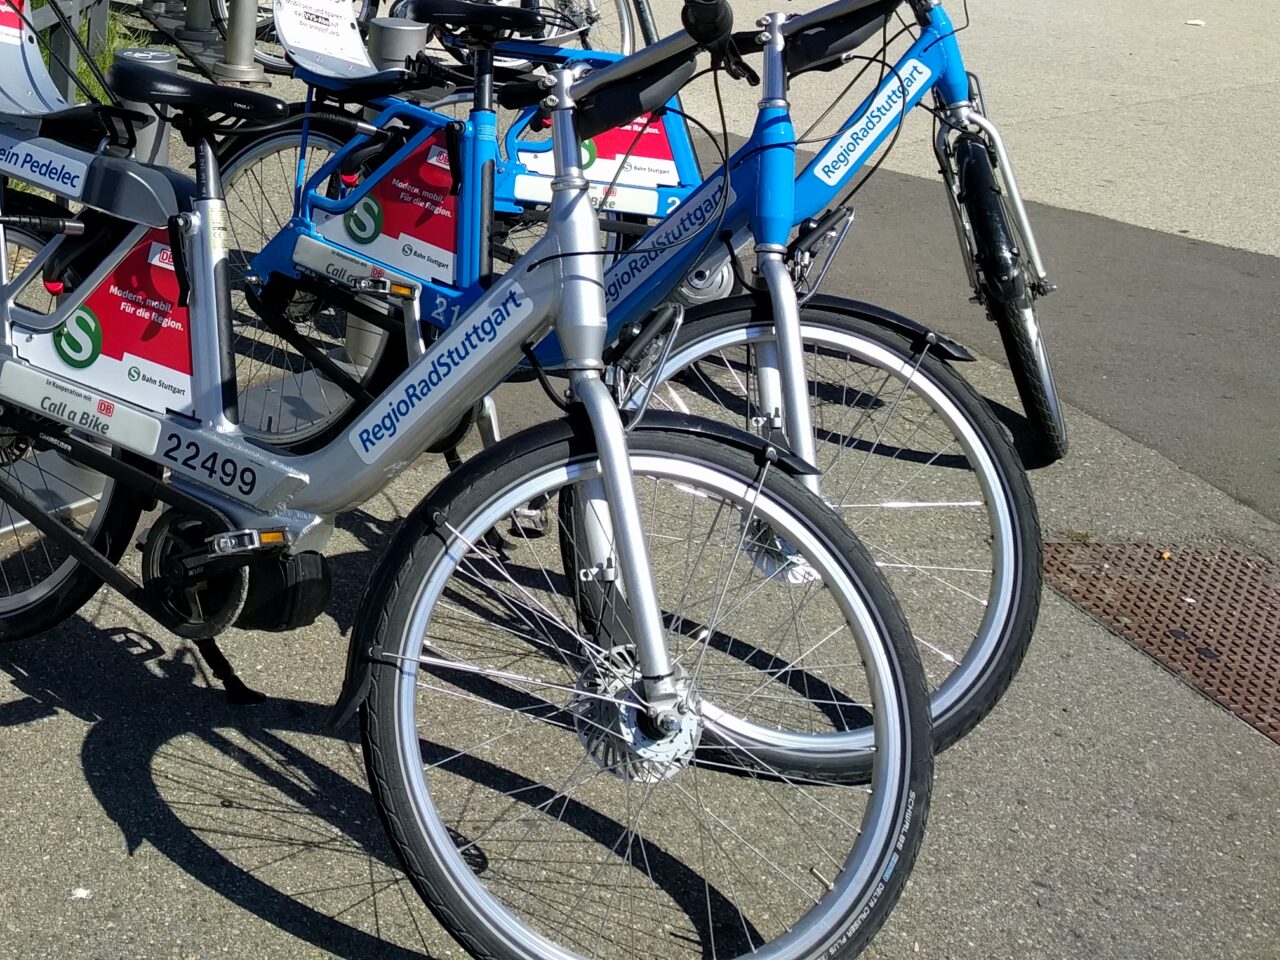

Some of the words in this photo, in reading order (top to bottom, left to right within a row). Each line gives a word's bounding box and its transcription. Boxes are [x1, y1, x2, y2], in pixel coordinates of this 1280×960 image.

[821, 64, 924, 180] RegioRadStuttgart
[21, 152, 80, 189] Pedelec
[647, 166, 670, 175] Stuttgart
[391, 178, 421, 196] Modern,
[421, 189, 444, 204] mobil.
[399, 192, 412, 203] Für
[413, 197, 424, 207] die
[425, 201, 452, 218] Region.
[604, 181, 727, 306] gioRadStuttgart
[325, 263, 347, 279] Call
[413, 250, 426, 261] Bahn
[426, 254, 449, 269] Stuttgart
[109, 285, 143, 305] Modern,
[145, 297, 173, 314] mobil.
[120, 302, 135, 315] Für
[136, 307, 150, 320] die
[151, 311, 184, 332] Region.
[141, 373, 157, 386] Bahn
[158, 377, 186, 396] Stuttgart
[356, 288, 525, 454] RegioRadStuttgart
[52, 381, 82, 398] Kooperation
[83, 393, 92, 402] mit
[40, 396, 66, 417] Call
[67, 410, 76, 421] a
[79, 412, 110, 435] Bike
[98, 401, 113, 416] DB
[163, 432, 257, 496] 22499
[896, 791, 916, 851] SCHWALBE
